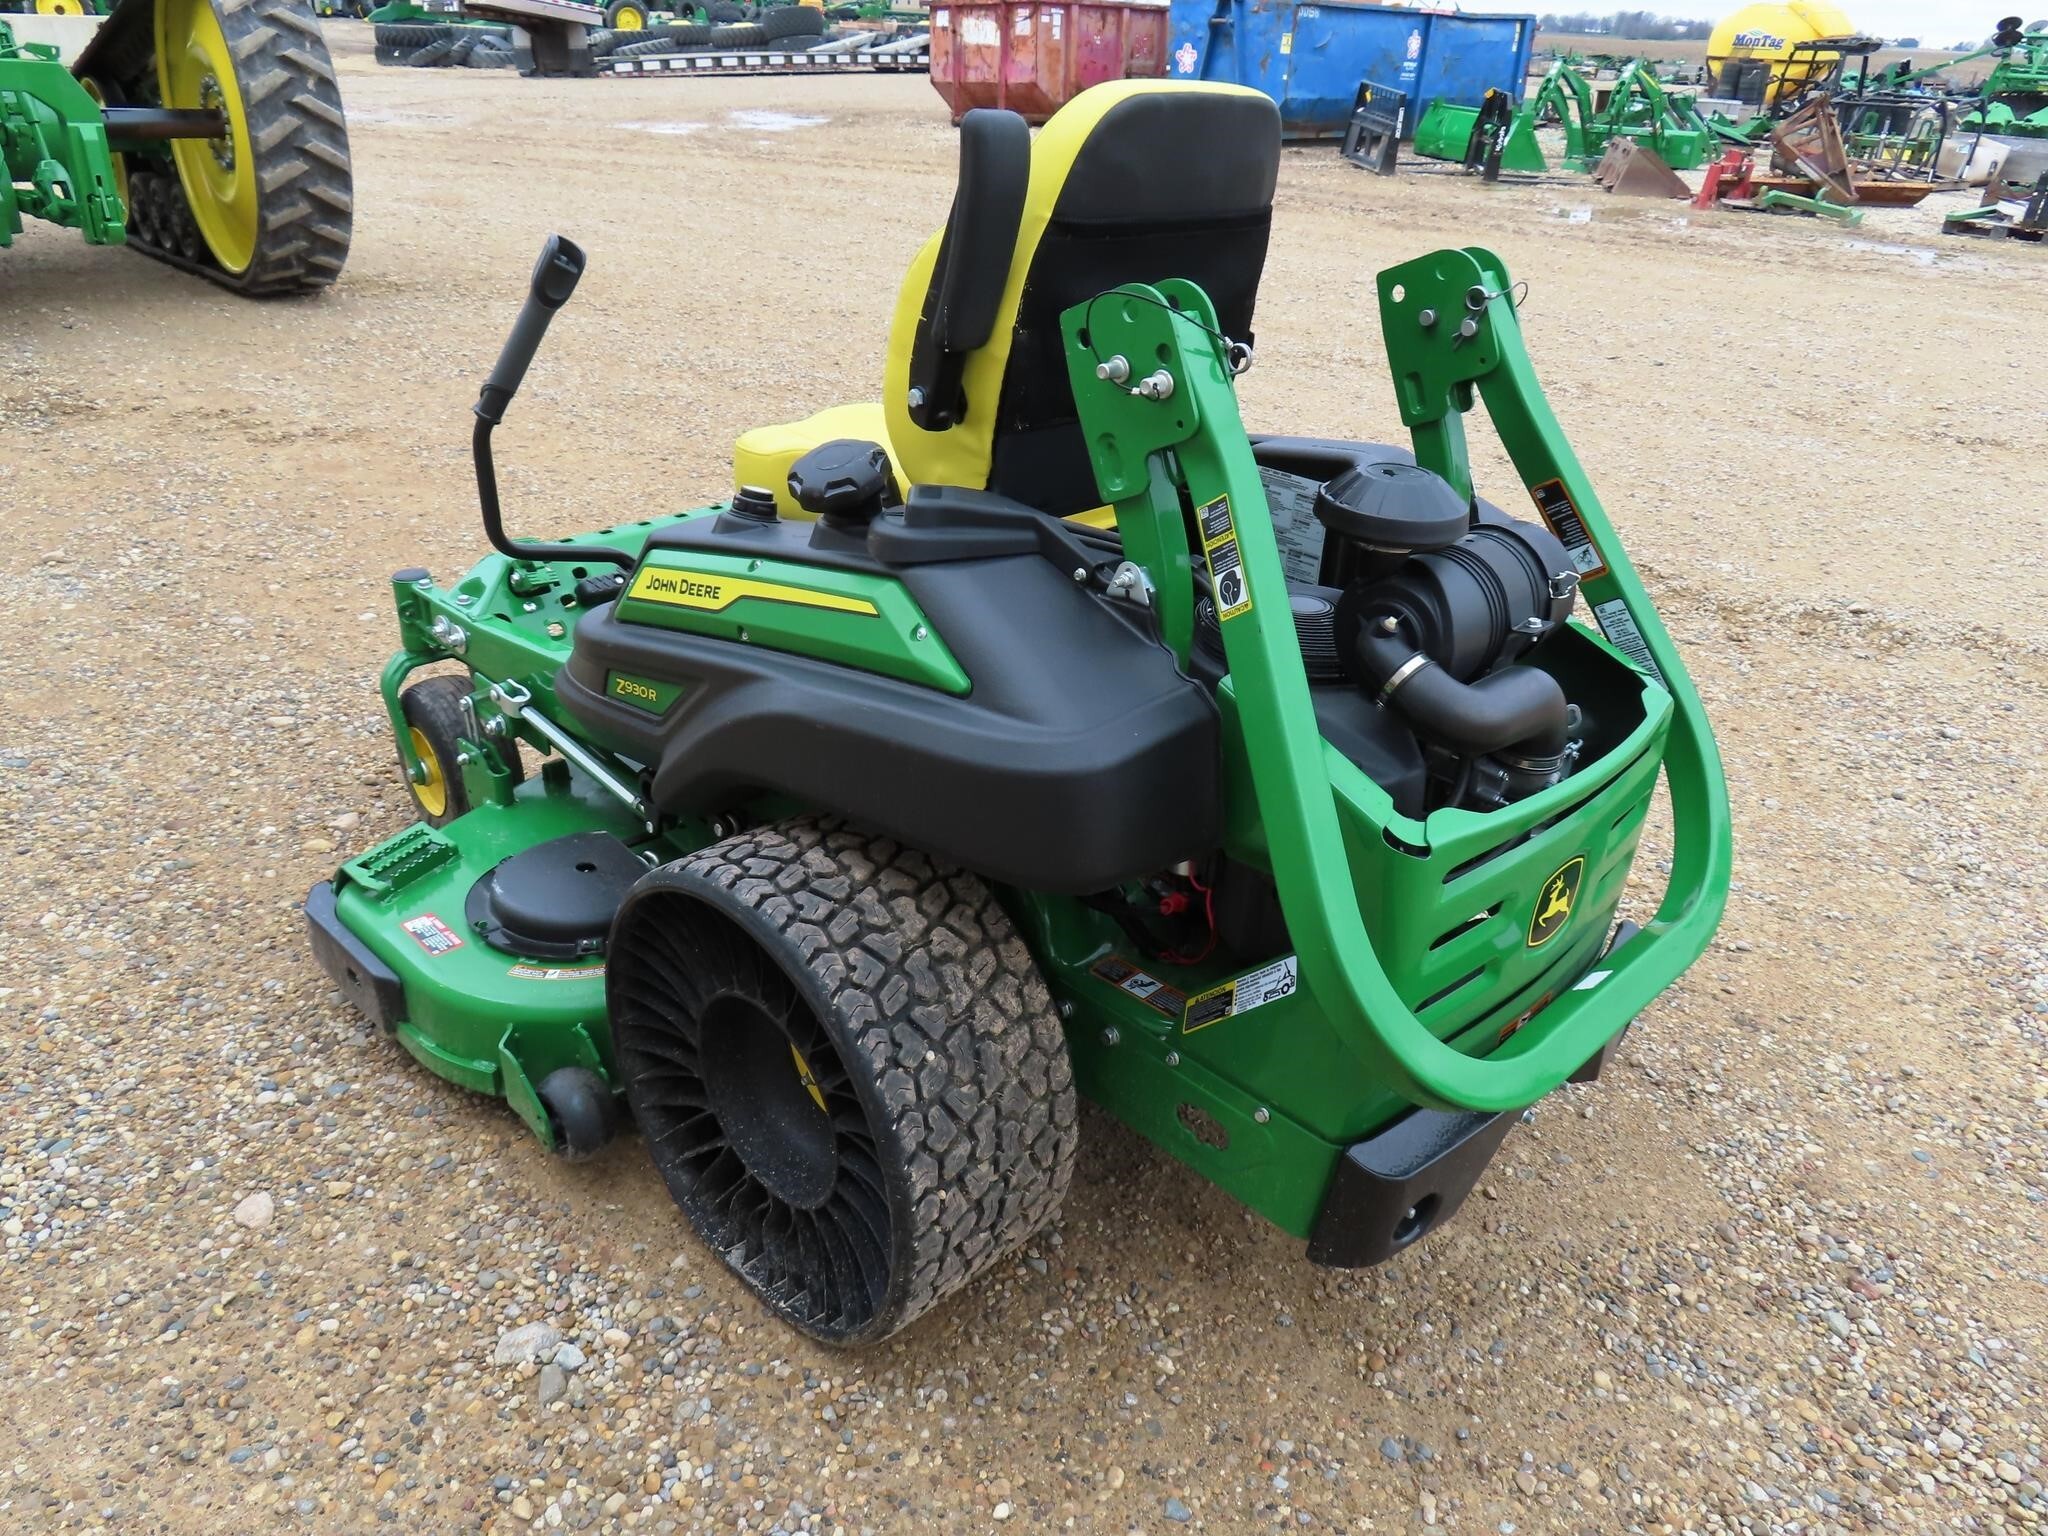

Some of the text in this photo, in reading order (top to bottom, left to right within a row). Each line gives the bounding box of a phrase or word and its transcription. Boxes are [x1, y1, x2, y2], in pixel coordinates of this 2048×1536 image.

[1732, 34, 1785, 50] MonTag
[646, 574, 721, 599] JOHN DEERE
[616, 678, 657, 701] Z930R
